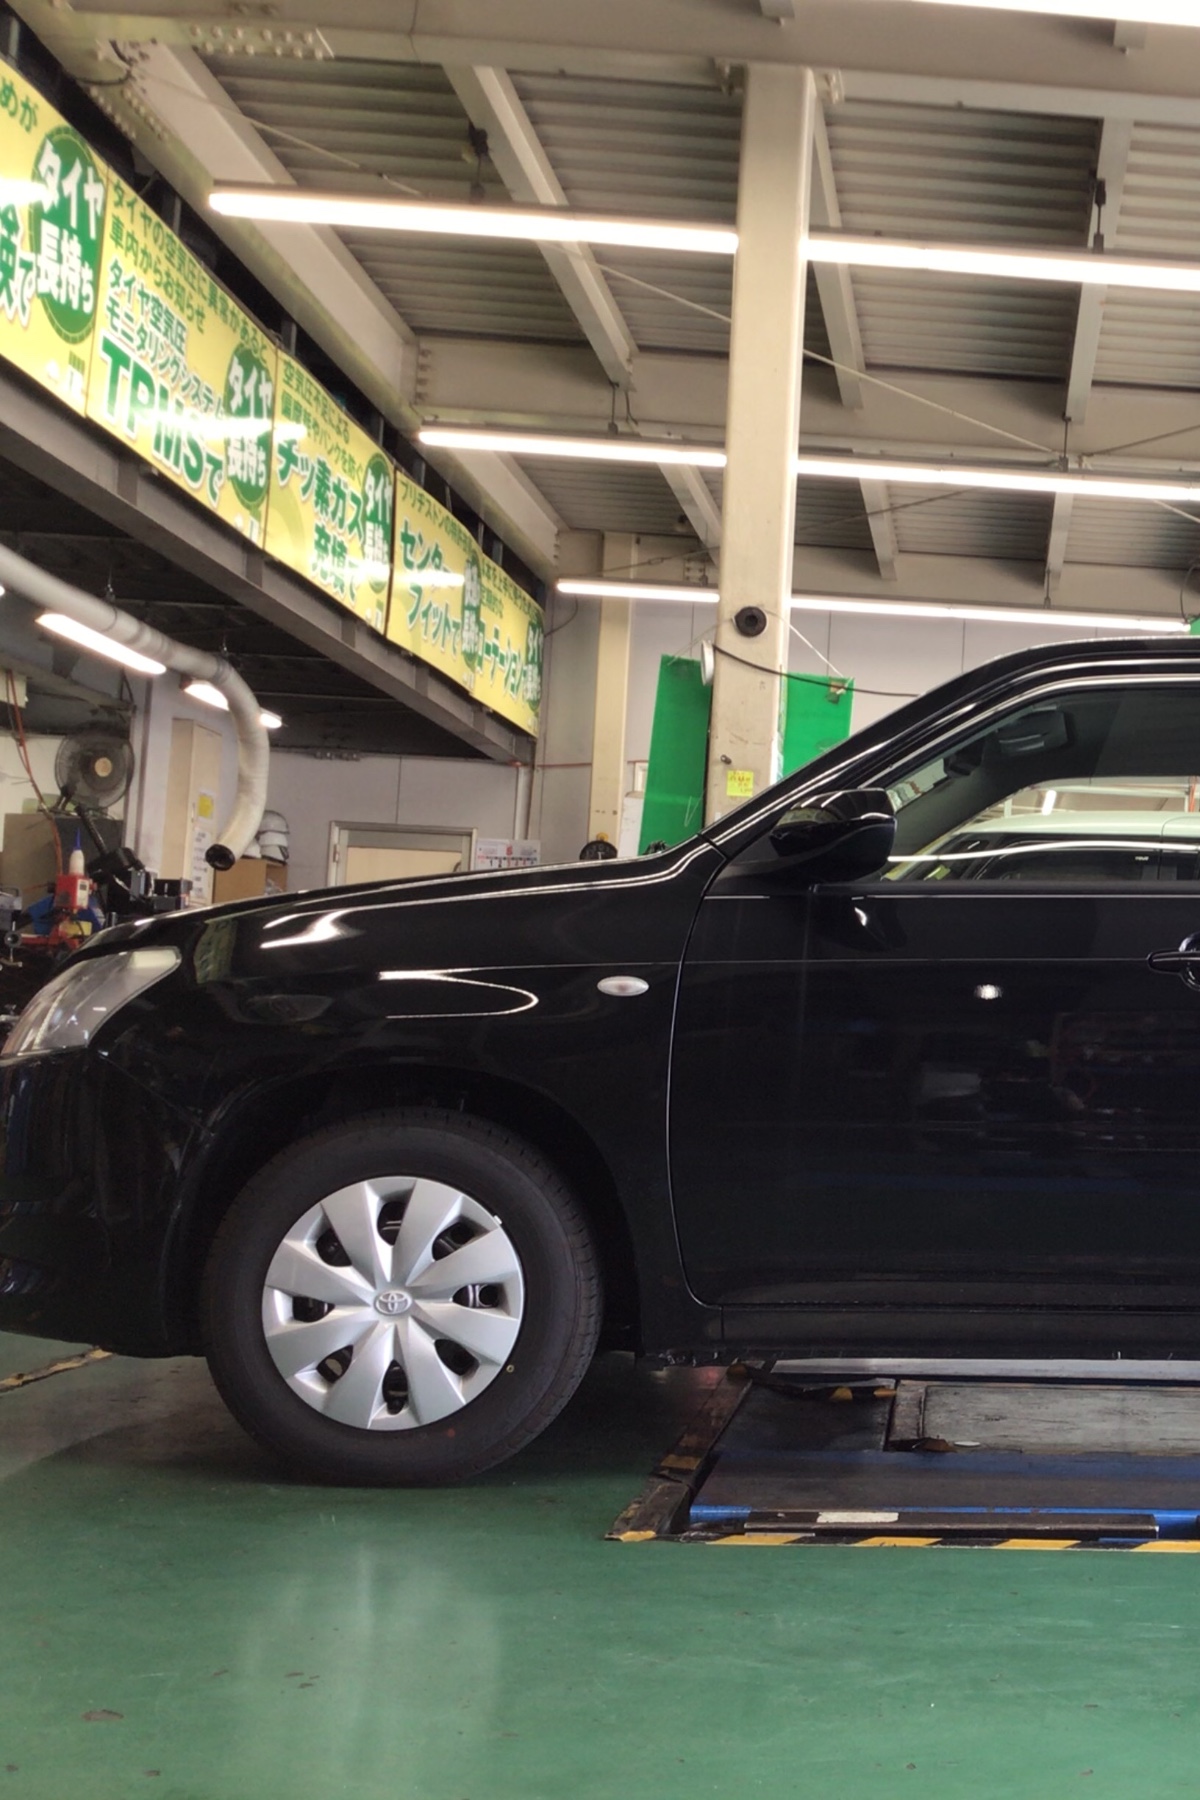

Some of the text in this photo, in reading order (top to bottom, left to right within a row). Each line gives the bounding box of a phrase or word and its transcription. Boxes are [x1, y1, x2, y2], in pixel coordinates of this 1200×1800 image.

[38, 138, 105, 240] タイヤ
[37, 218, 95, 314] 長持ち
[109, 213, 206, 335] 車内からお知らせ
[109, 259, 187, 358] タイヤ空気圧
[228, 355, 273, 421] タイヤ
[277, 438, 366, 542] チッ素ガス
